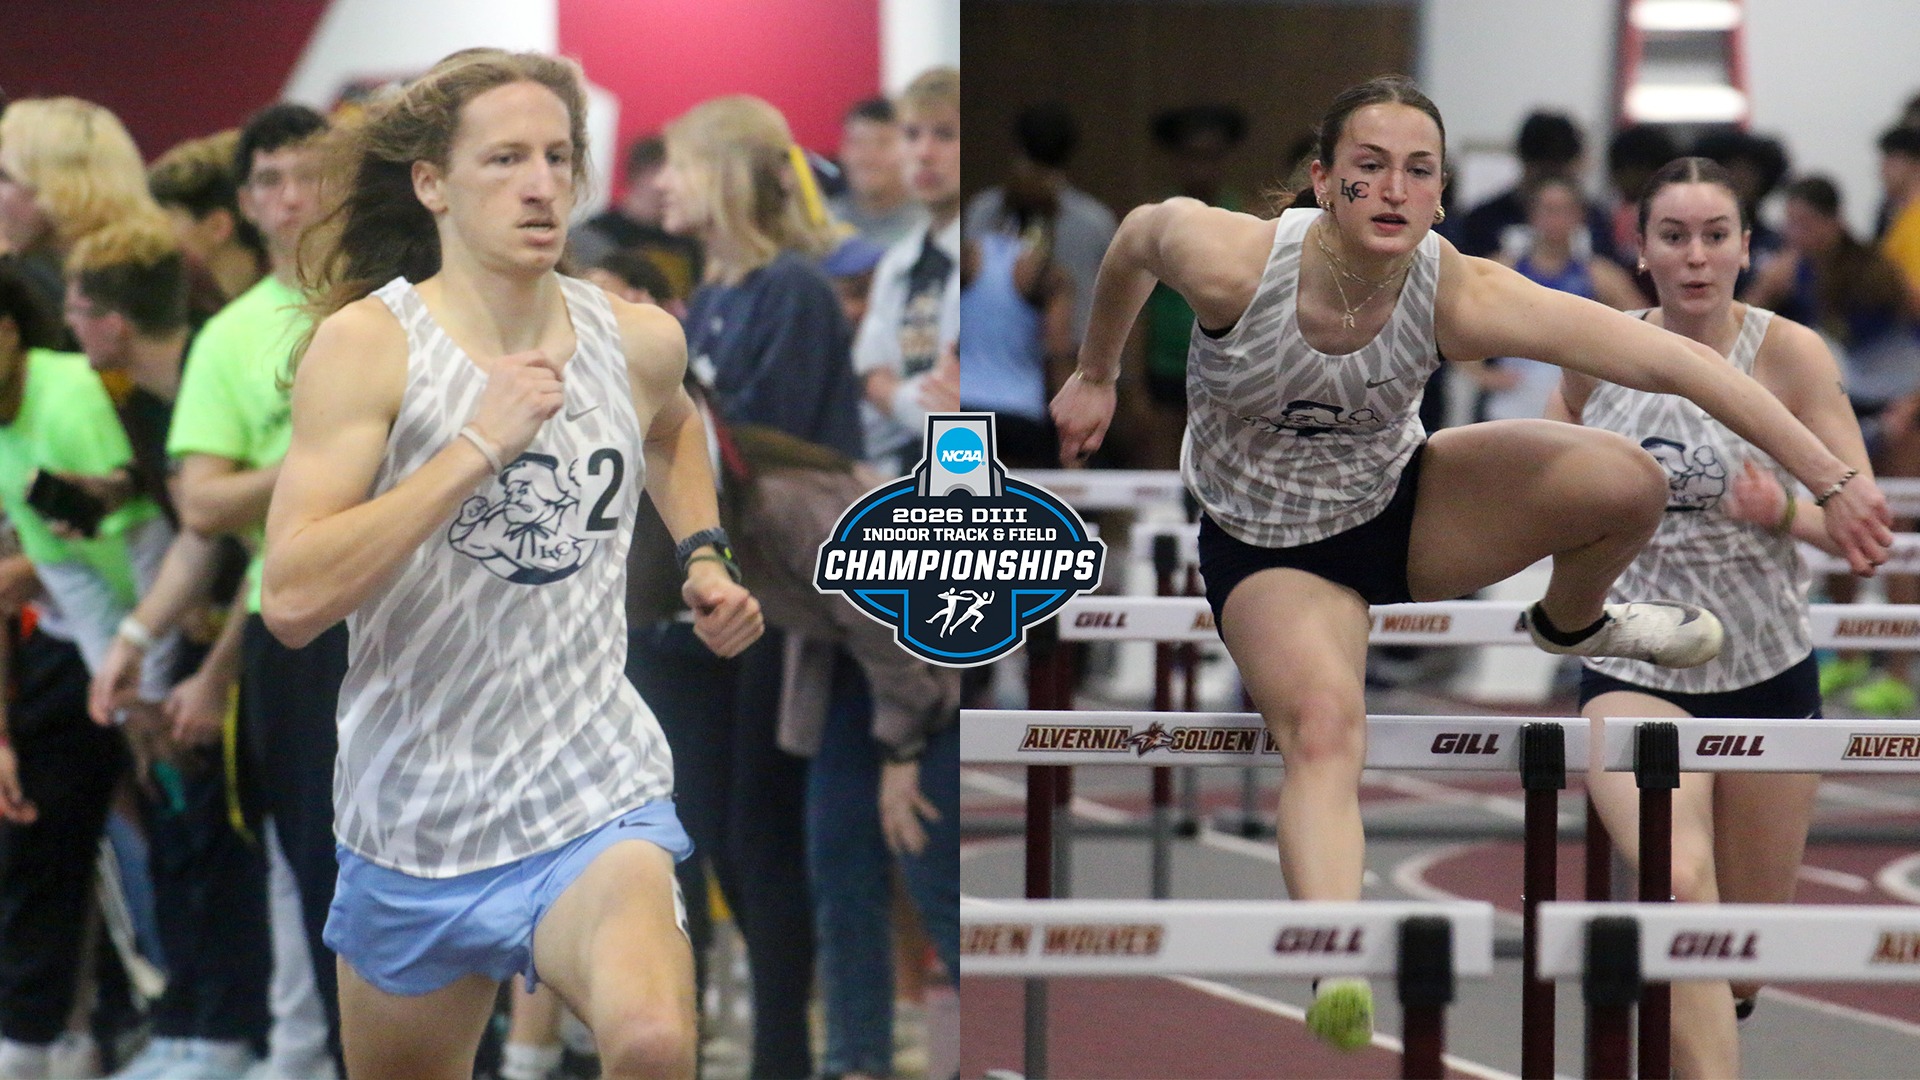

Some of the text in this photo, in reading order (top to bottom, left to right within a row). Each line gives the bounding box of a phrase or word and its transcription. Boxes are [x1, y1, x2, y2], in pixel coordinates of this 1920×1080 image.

[1340, 177, 1370, 204] LVC
[586, 447, 624, 532] 2
[1023, 726, 1131, 749] ALVERNIA
[1171, 727, 1258, 751] GOLDEN
[1430, 732, 1500, 755] GILL
[1696, 735, 1764, 756] GILL
[1273, 926, 1364, 954] GILL
[1669, 930, 1758, 960] GILL
